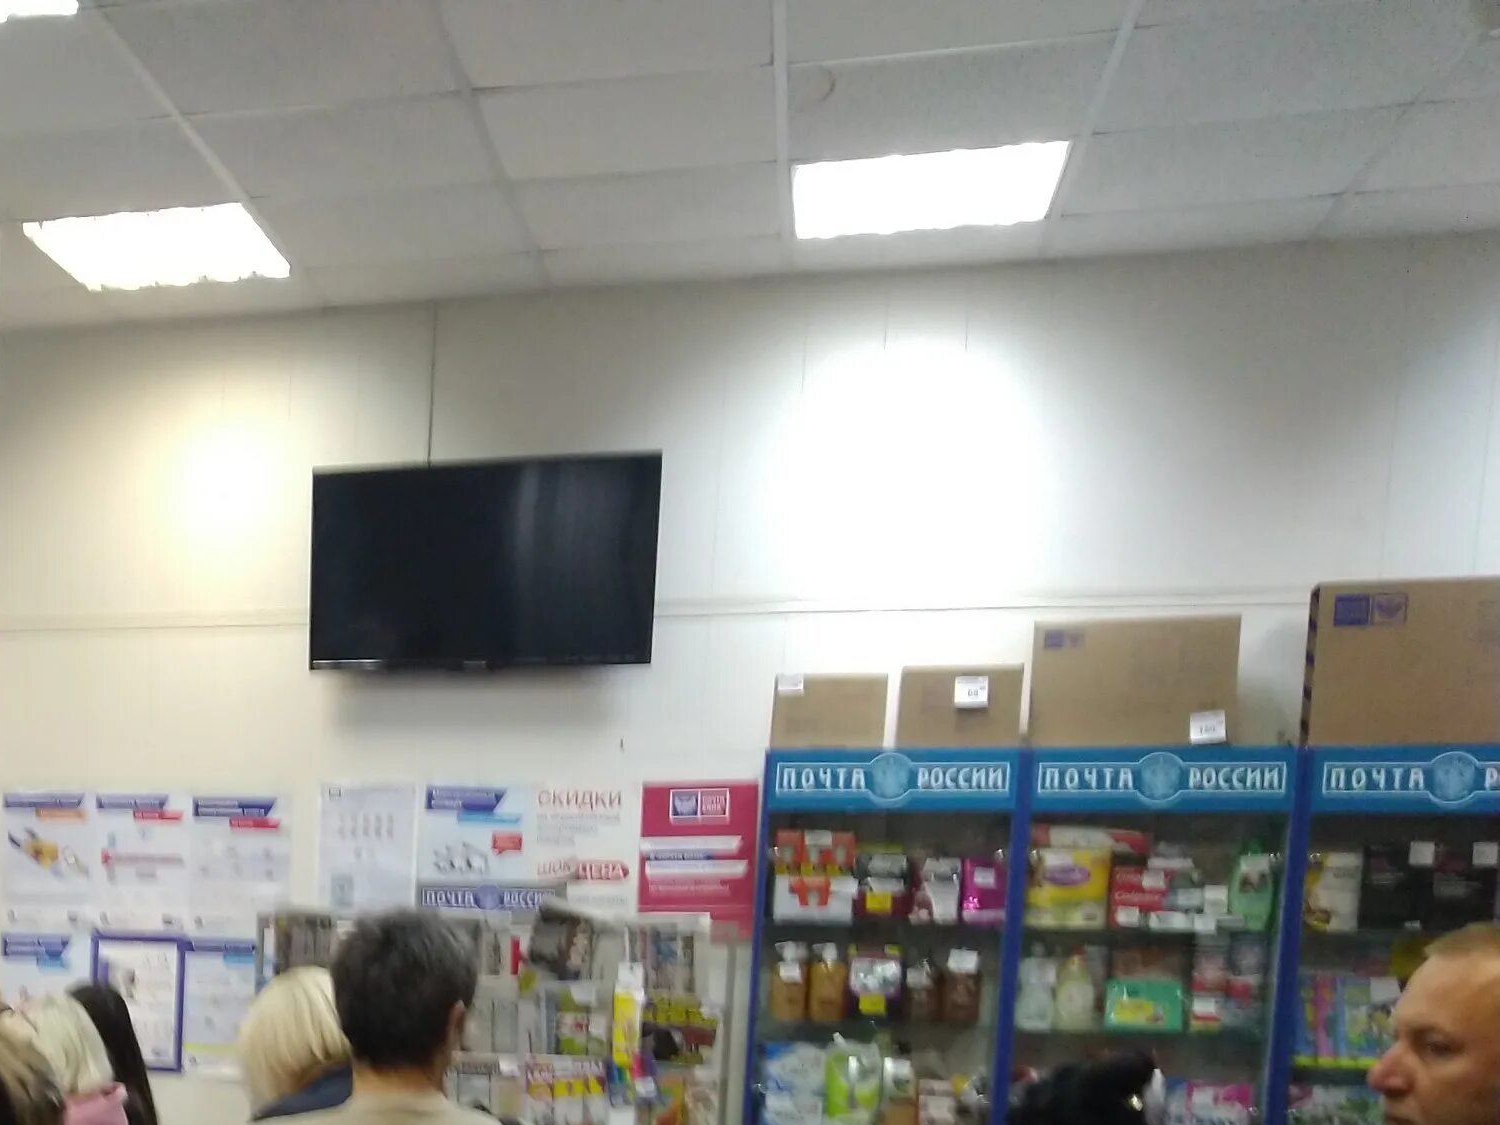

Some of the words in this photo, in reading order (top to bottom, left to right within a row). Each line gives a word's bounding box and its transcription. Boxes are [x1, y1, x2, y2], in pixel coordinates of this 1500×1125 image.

[782, 767, 867, 791] ПОЧТА
[917, 767, 1003, 790] РОССИИ
[1044, 767, 1134, 790] ПОЧТА
[1187, 767, 1280, 790] РОССИИ
[1329, 767, 1426, 791] ПОЧТА
[538, 789, 622, 812] СКИДКИ
[578, 862, 626, 882] ЦЕНА
[426, 889, 478, 908] ПОЧТА
